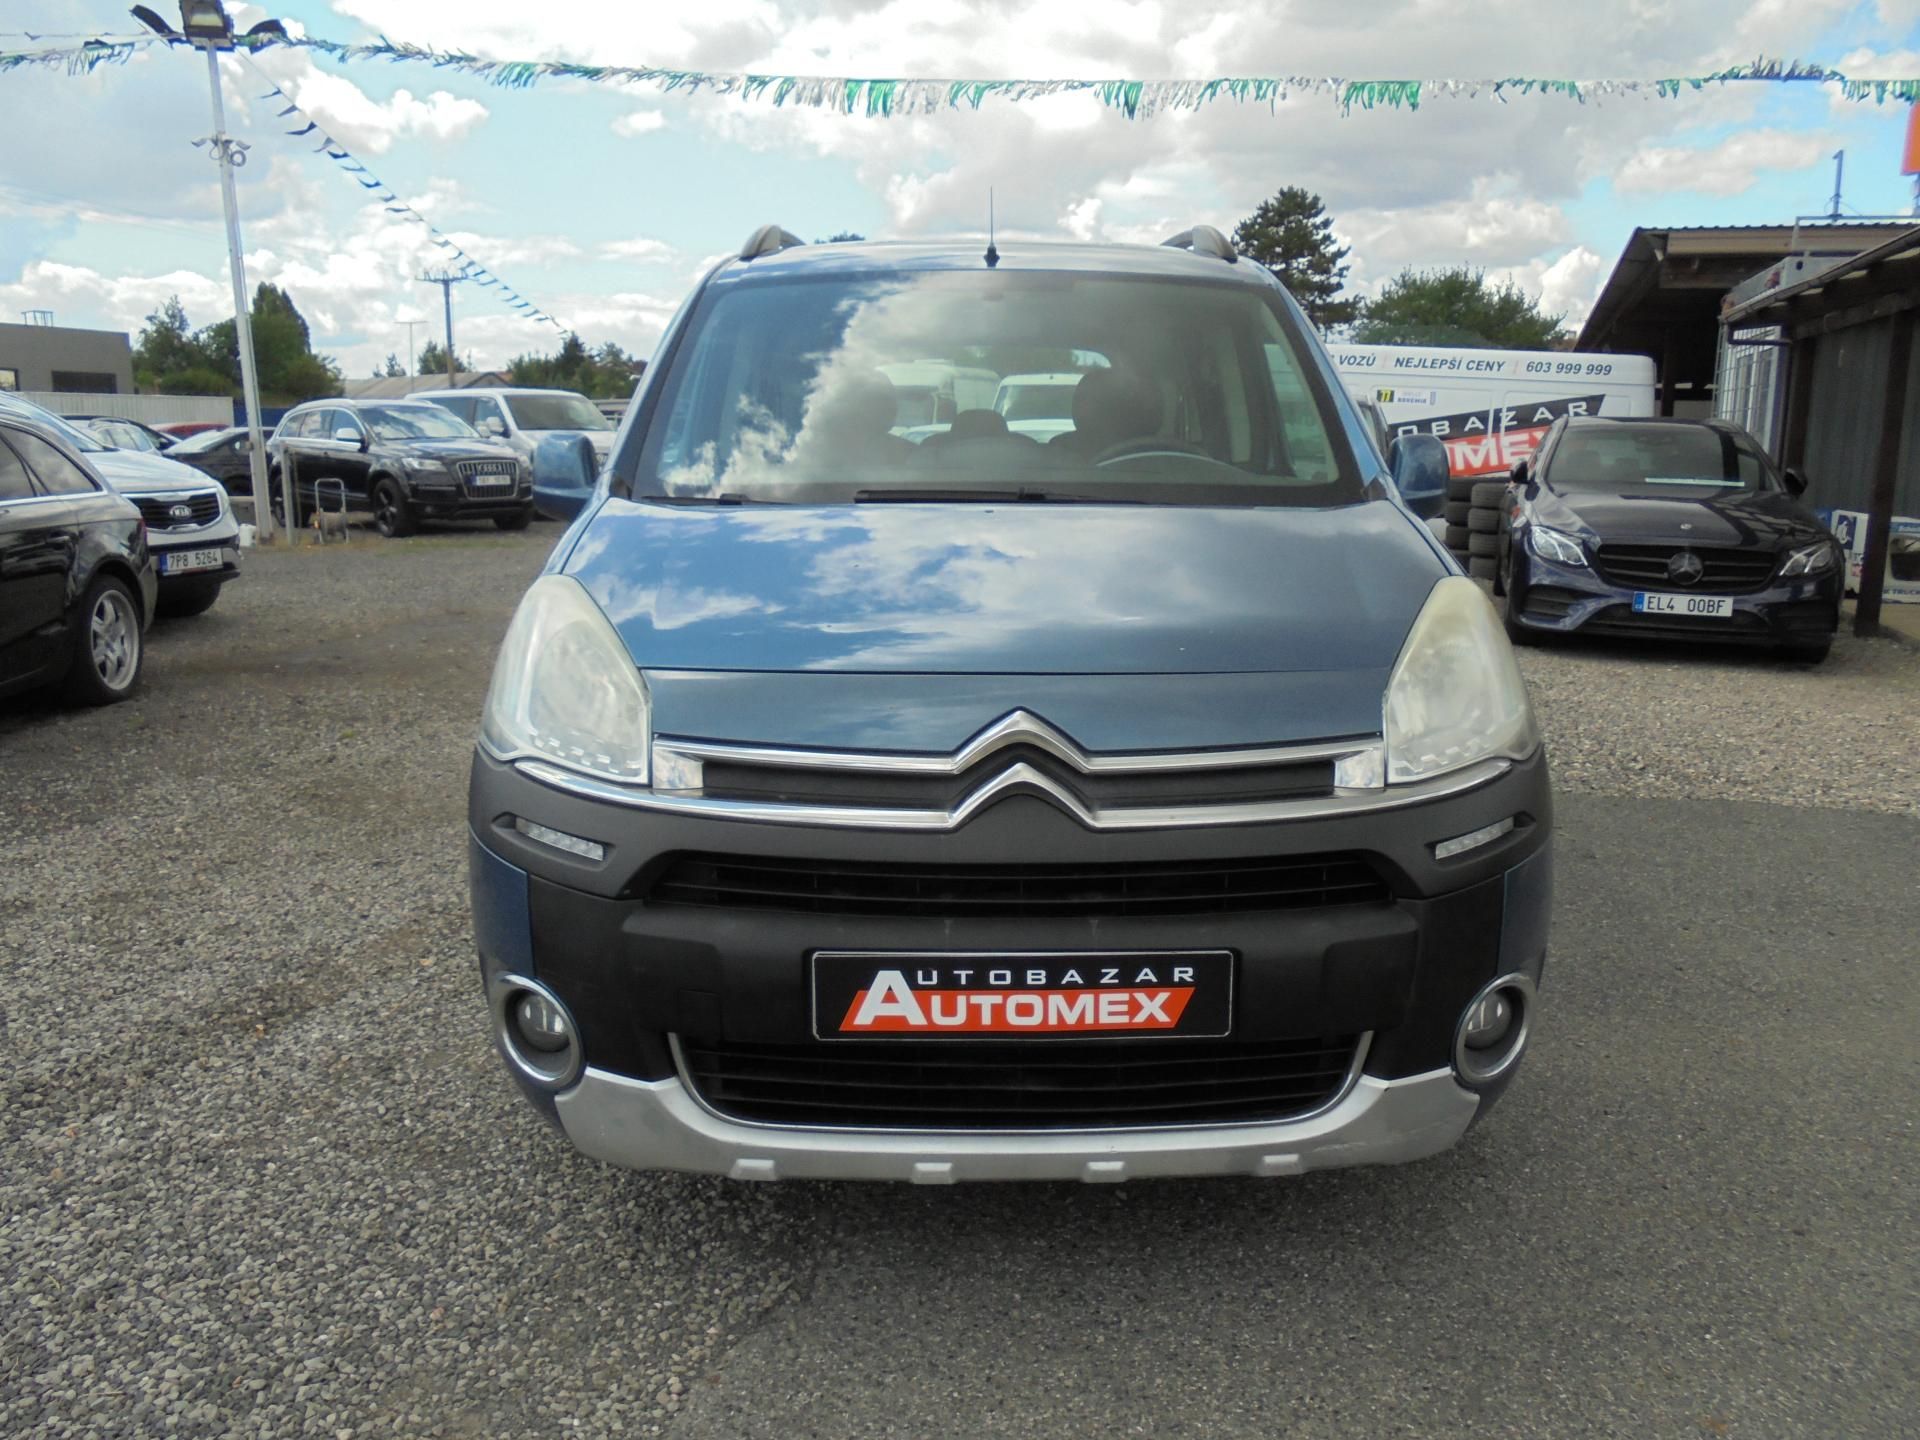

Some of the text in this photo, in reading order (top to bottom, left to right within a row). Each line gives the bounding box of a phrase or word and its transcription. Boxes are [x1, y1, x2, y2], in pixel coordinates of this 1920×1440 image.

[1394, 356, 1506, 372] NEJLEPŠÍ CENY
[1526, 361, 1613, 376] 603 999 999
[169, 554, 189, 569] 7P8
[1647, 595, 1675, 611] EL4
[853, 970, 1172, 1026] AUTOMEX
